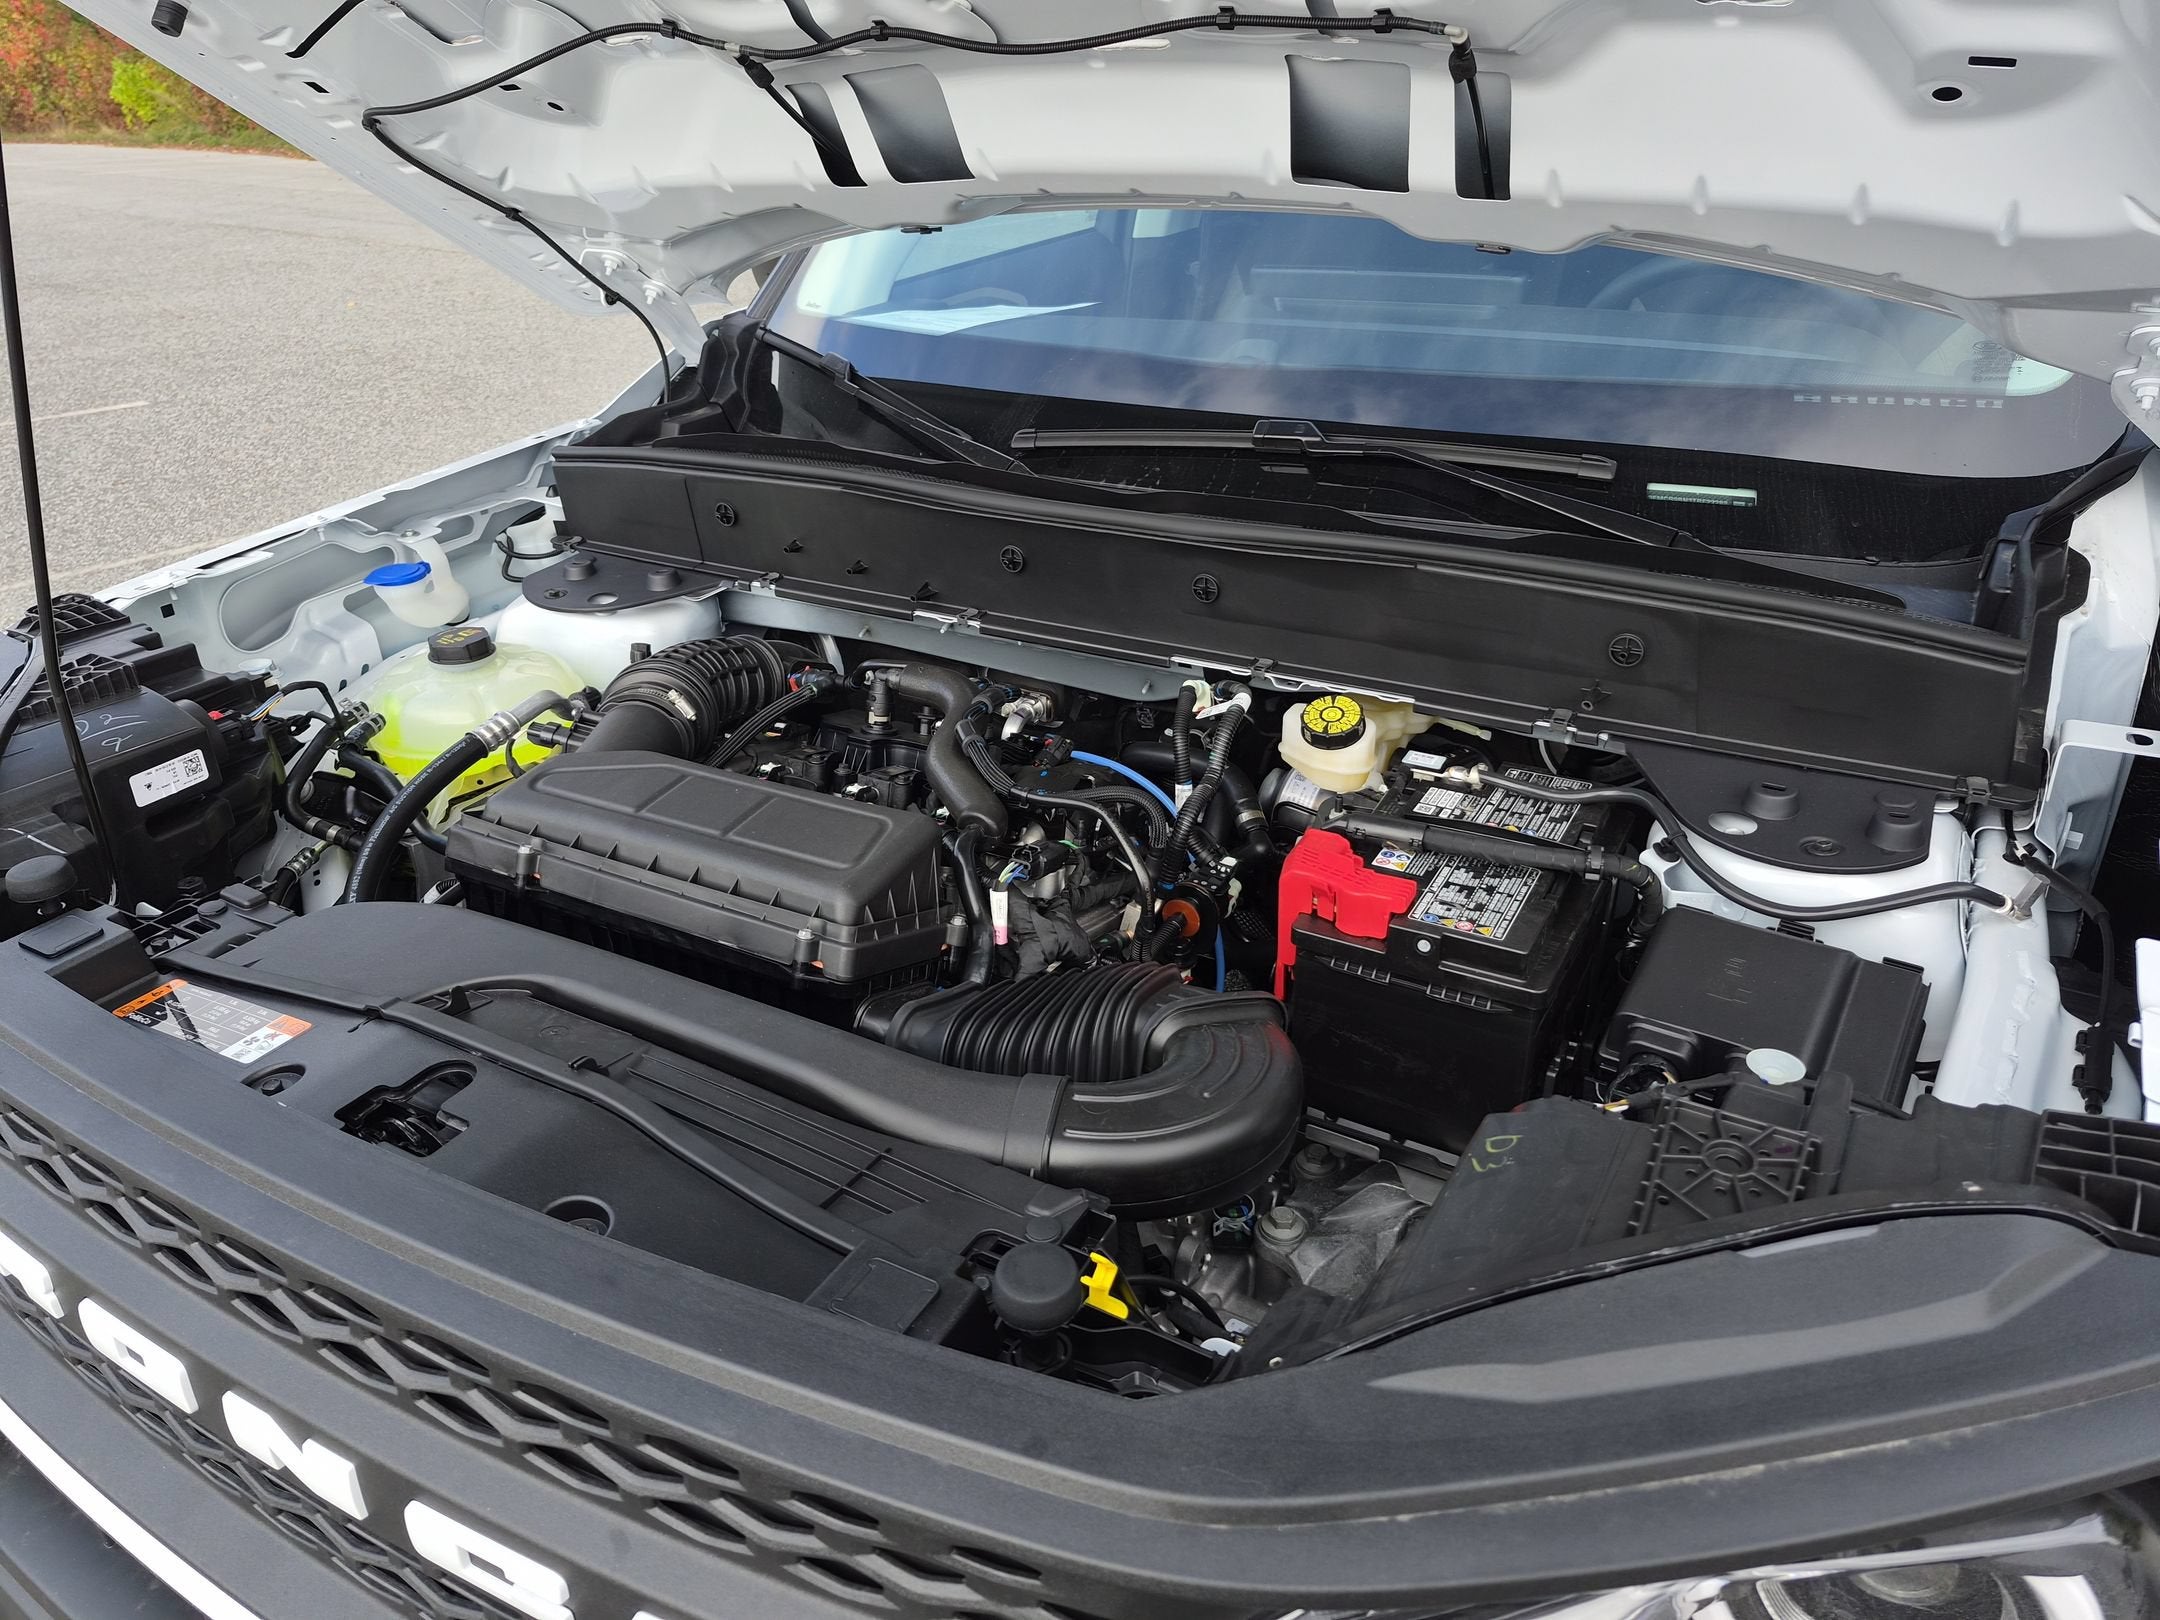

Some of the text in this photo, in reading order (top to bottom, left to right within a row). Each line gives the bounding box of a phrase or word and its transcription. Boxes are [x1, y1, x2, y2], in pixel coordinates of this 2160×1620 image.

[1793, 394, 2004, 409] BRONCO
[395, 784, 416, 805] SUCTION
[414, 772, 429, 785] HOSE
